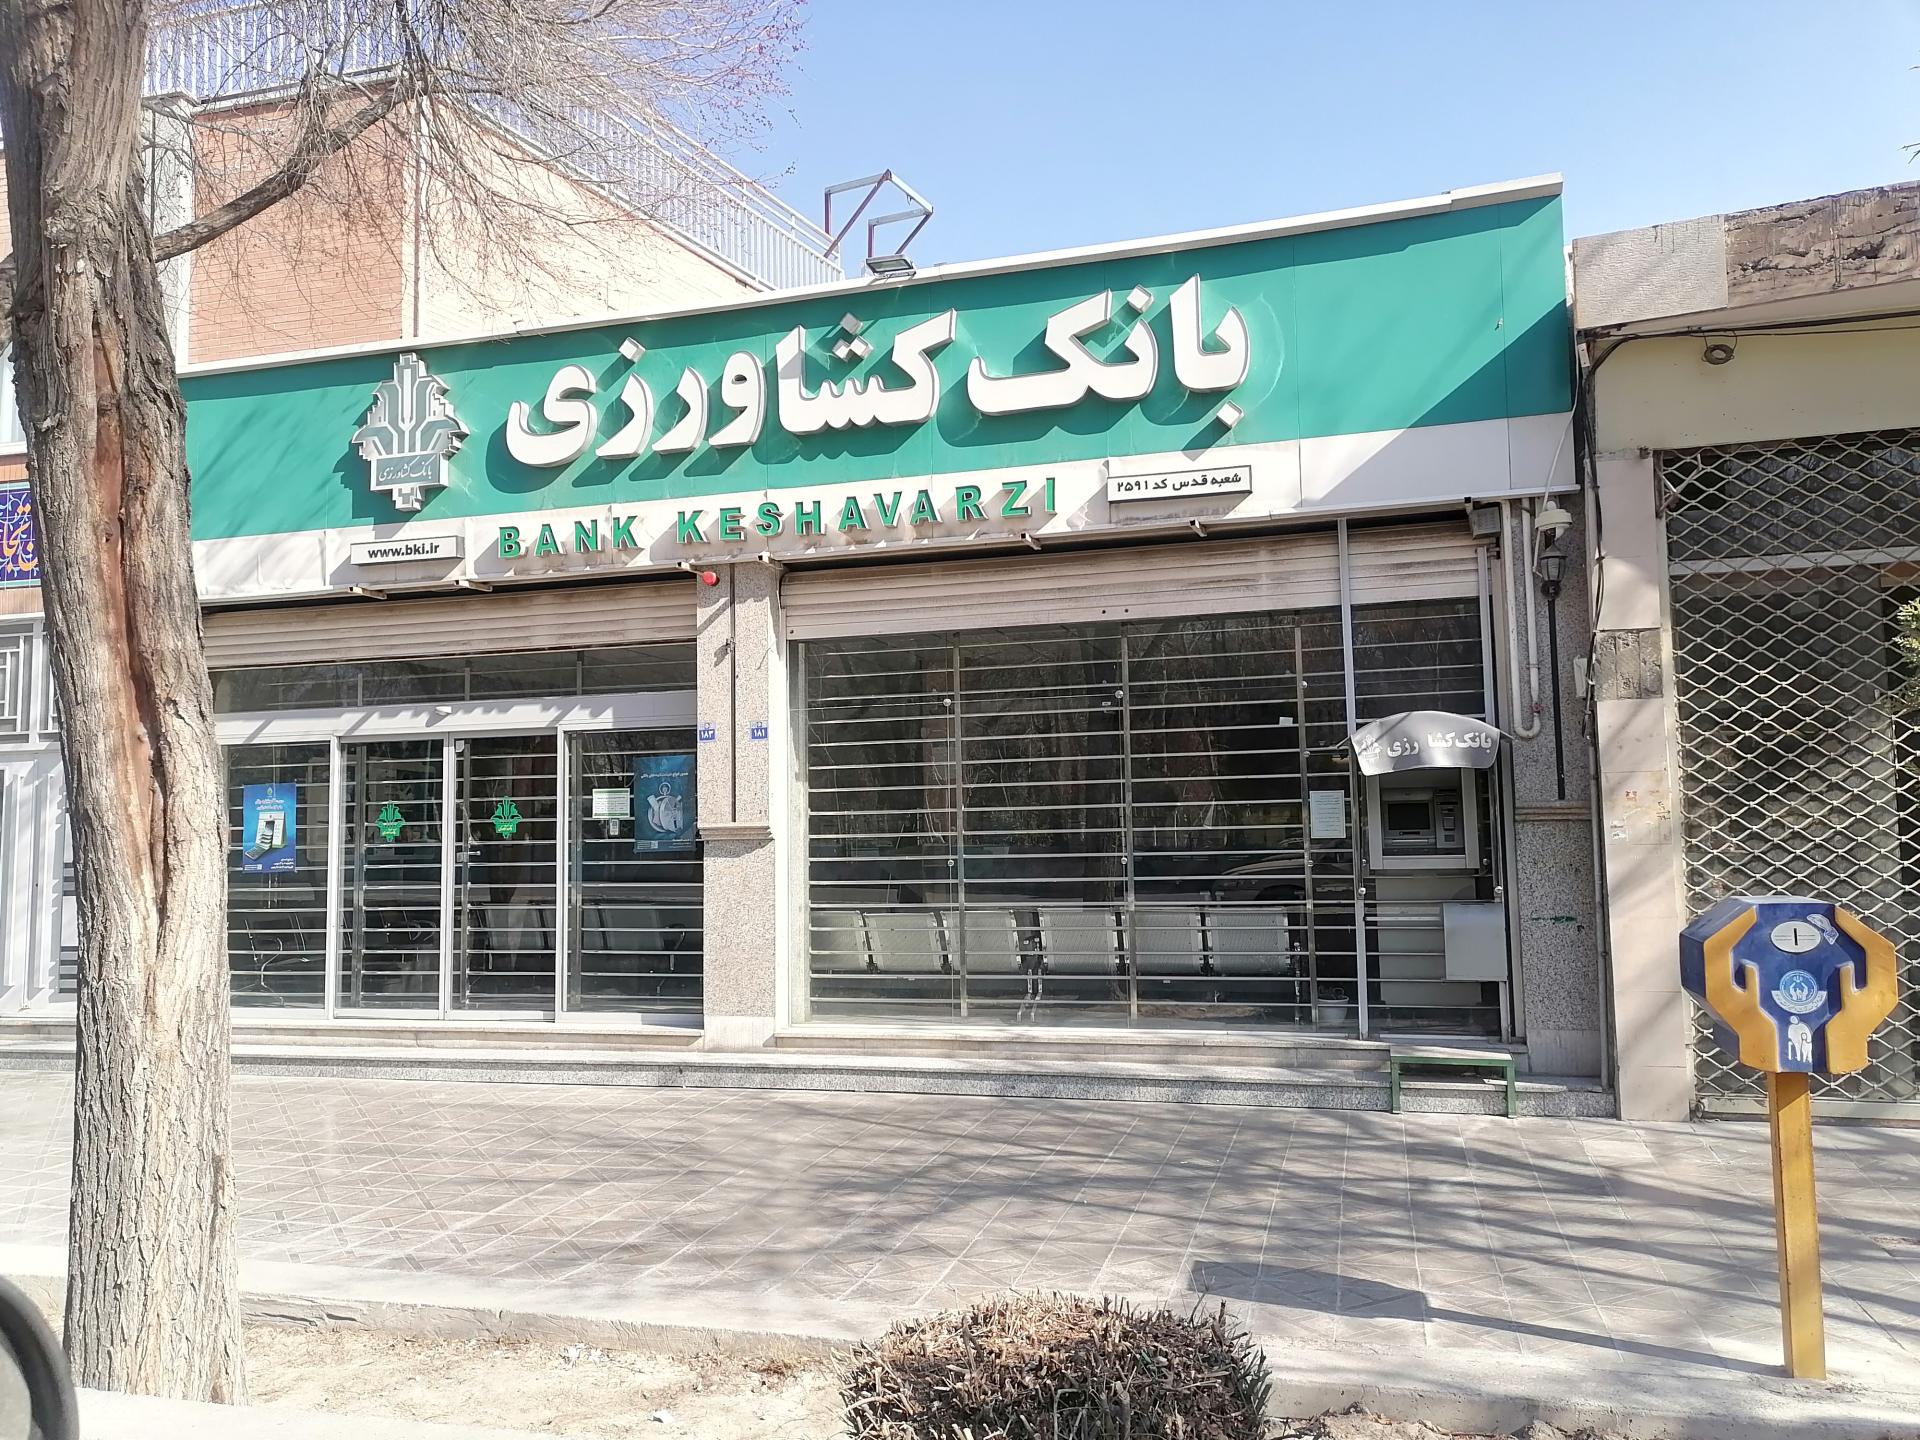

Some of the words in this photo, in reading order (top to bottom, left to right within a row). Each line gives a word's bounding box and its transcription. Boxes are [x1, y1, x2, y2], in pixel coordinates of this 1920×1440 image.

[967, 273, 1252, 431] بانک
[506, 309, 958, 467] کشاورزی
[378, 456, 420, 481] کشاورزی
[410, 455, 436, 479] بانک
[1117, 480, 1149, 492] ۲۵۹۱
[1152, 478, 1168, 490] کد
[1172, 474, 1208, 491] قدس
[1211, 472, 1242, 488] شعبه
[498, 514, 641, 560] BANK
[676, 477, 1058, 545] KESHAVARZI
[367, 542, 440, 559] www.bki.ir
[1455, 731, 1492, 753] بانک
